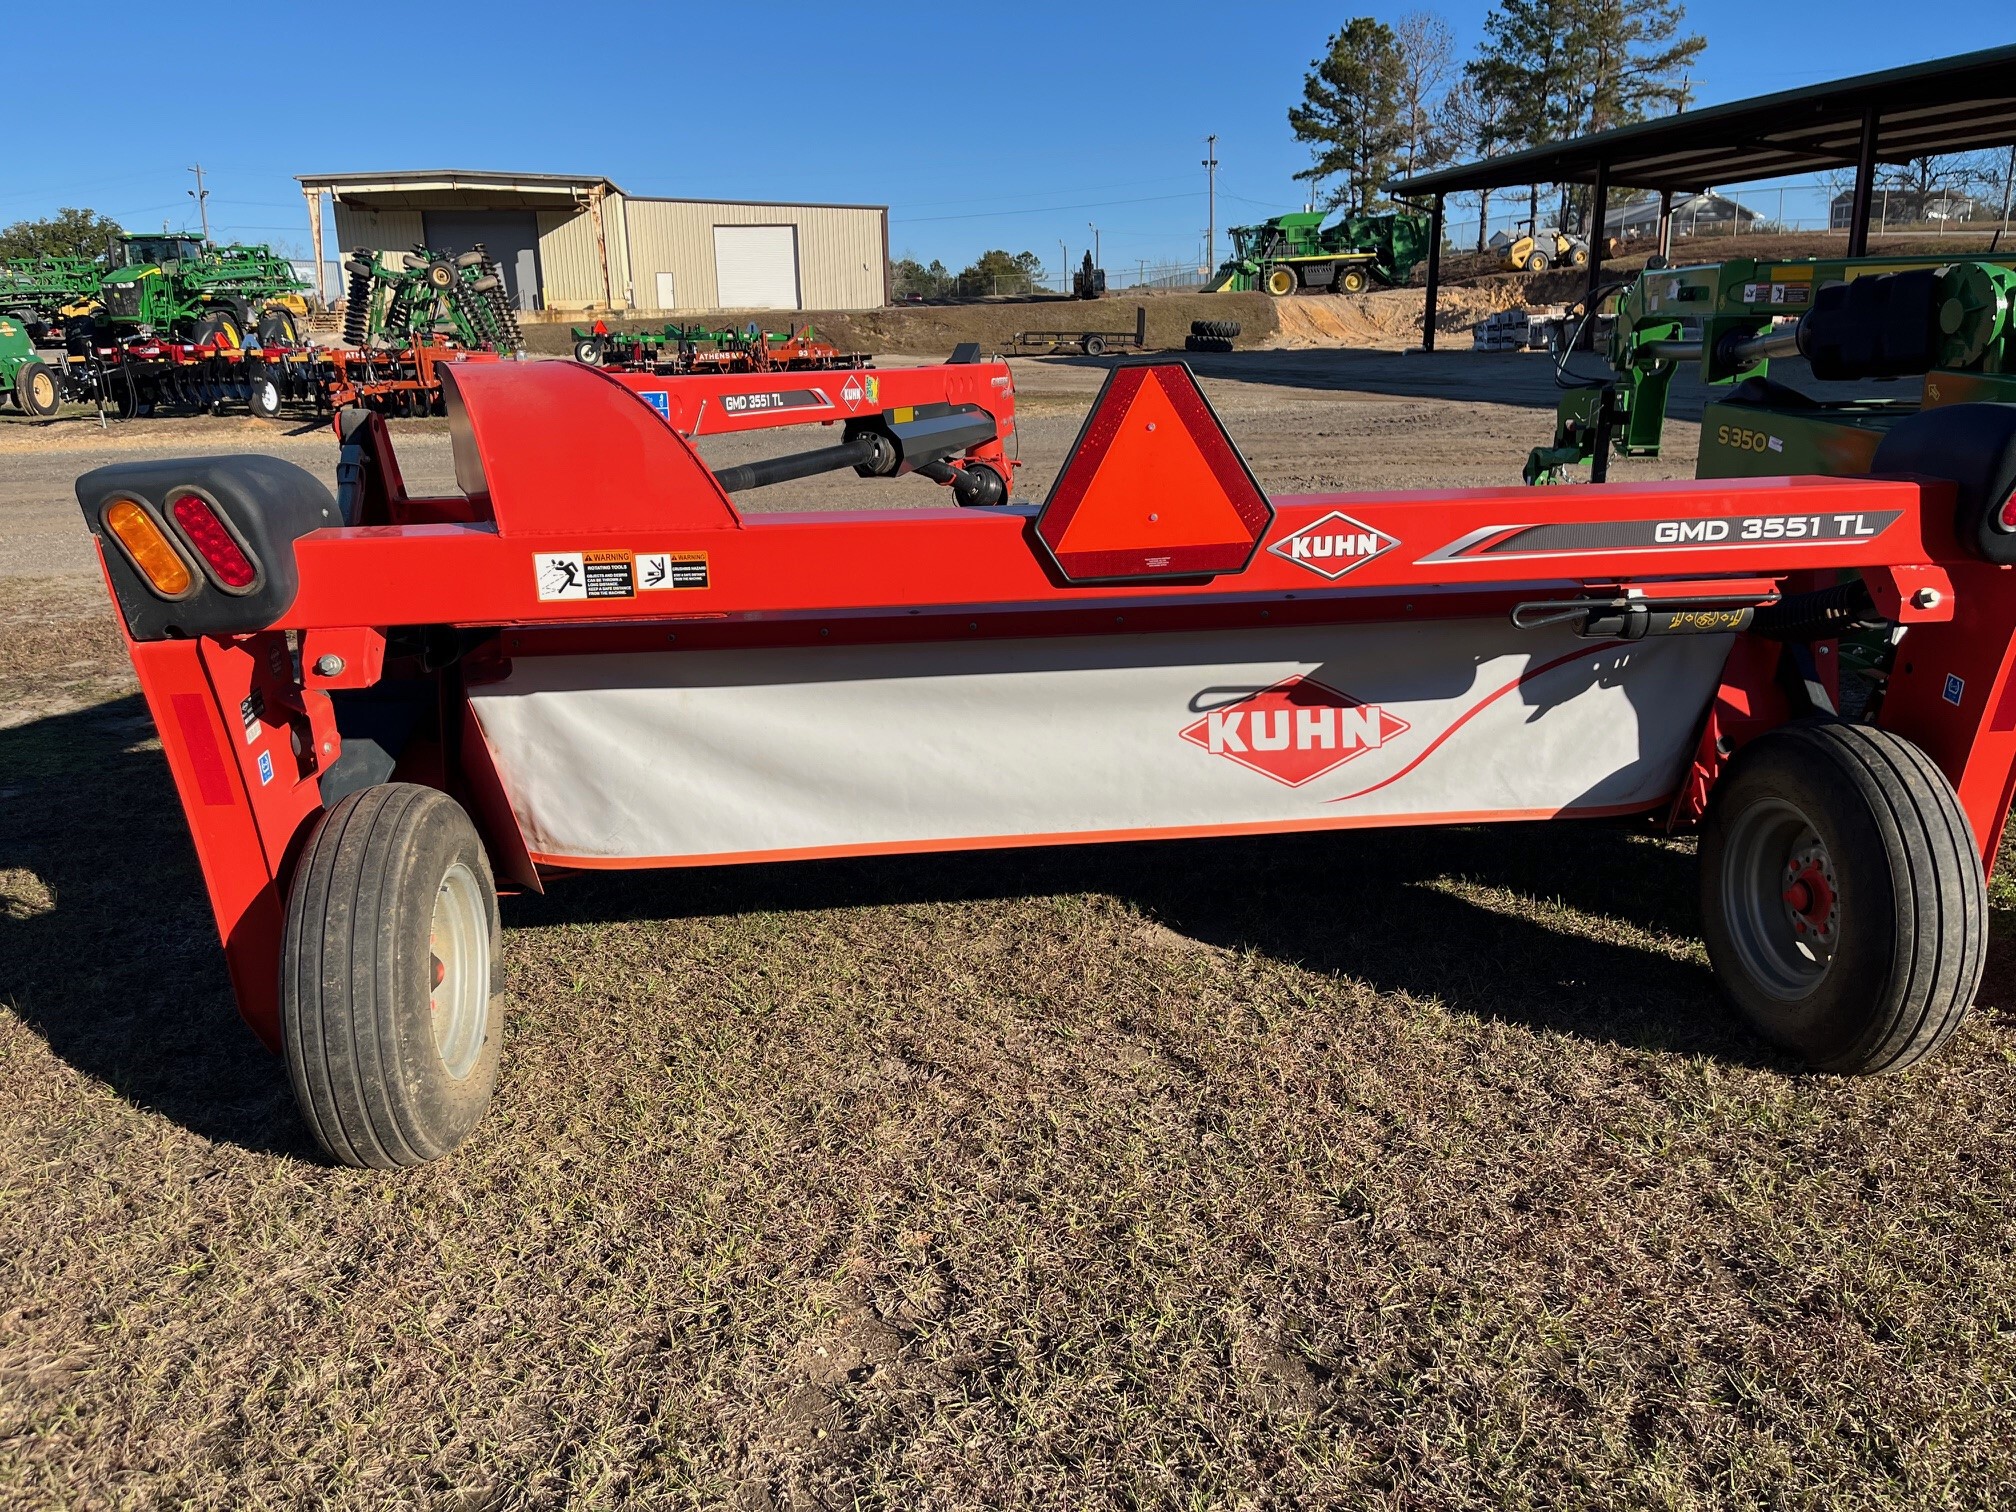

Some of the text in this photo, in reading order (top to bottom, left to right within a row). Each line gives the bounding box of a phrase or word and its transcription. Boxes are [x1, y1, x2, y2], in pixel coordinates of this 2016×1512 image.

[699, 352, 731, 360] ATHENS
[726, 393, 784, 411] GMD 3551 TL
[844, 387, 861, 401] KUHN
[1654, 514, 1875, 543] GMD 3551 TL
[1291, 533, 1378, 559] KUHN
[593, 553, 629, 562] WARNING
[677, 553, 706, 561] WARNING
[1208, 706, 1381, 753] KUHN
